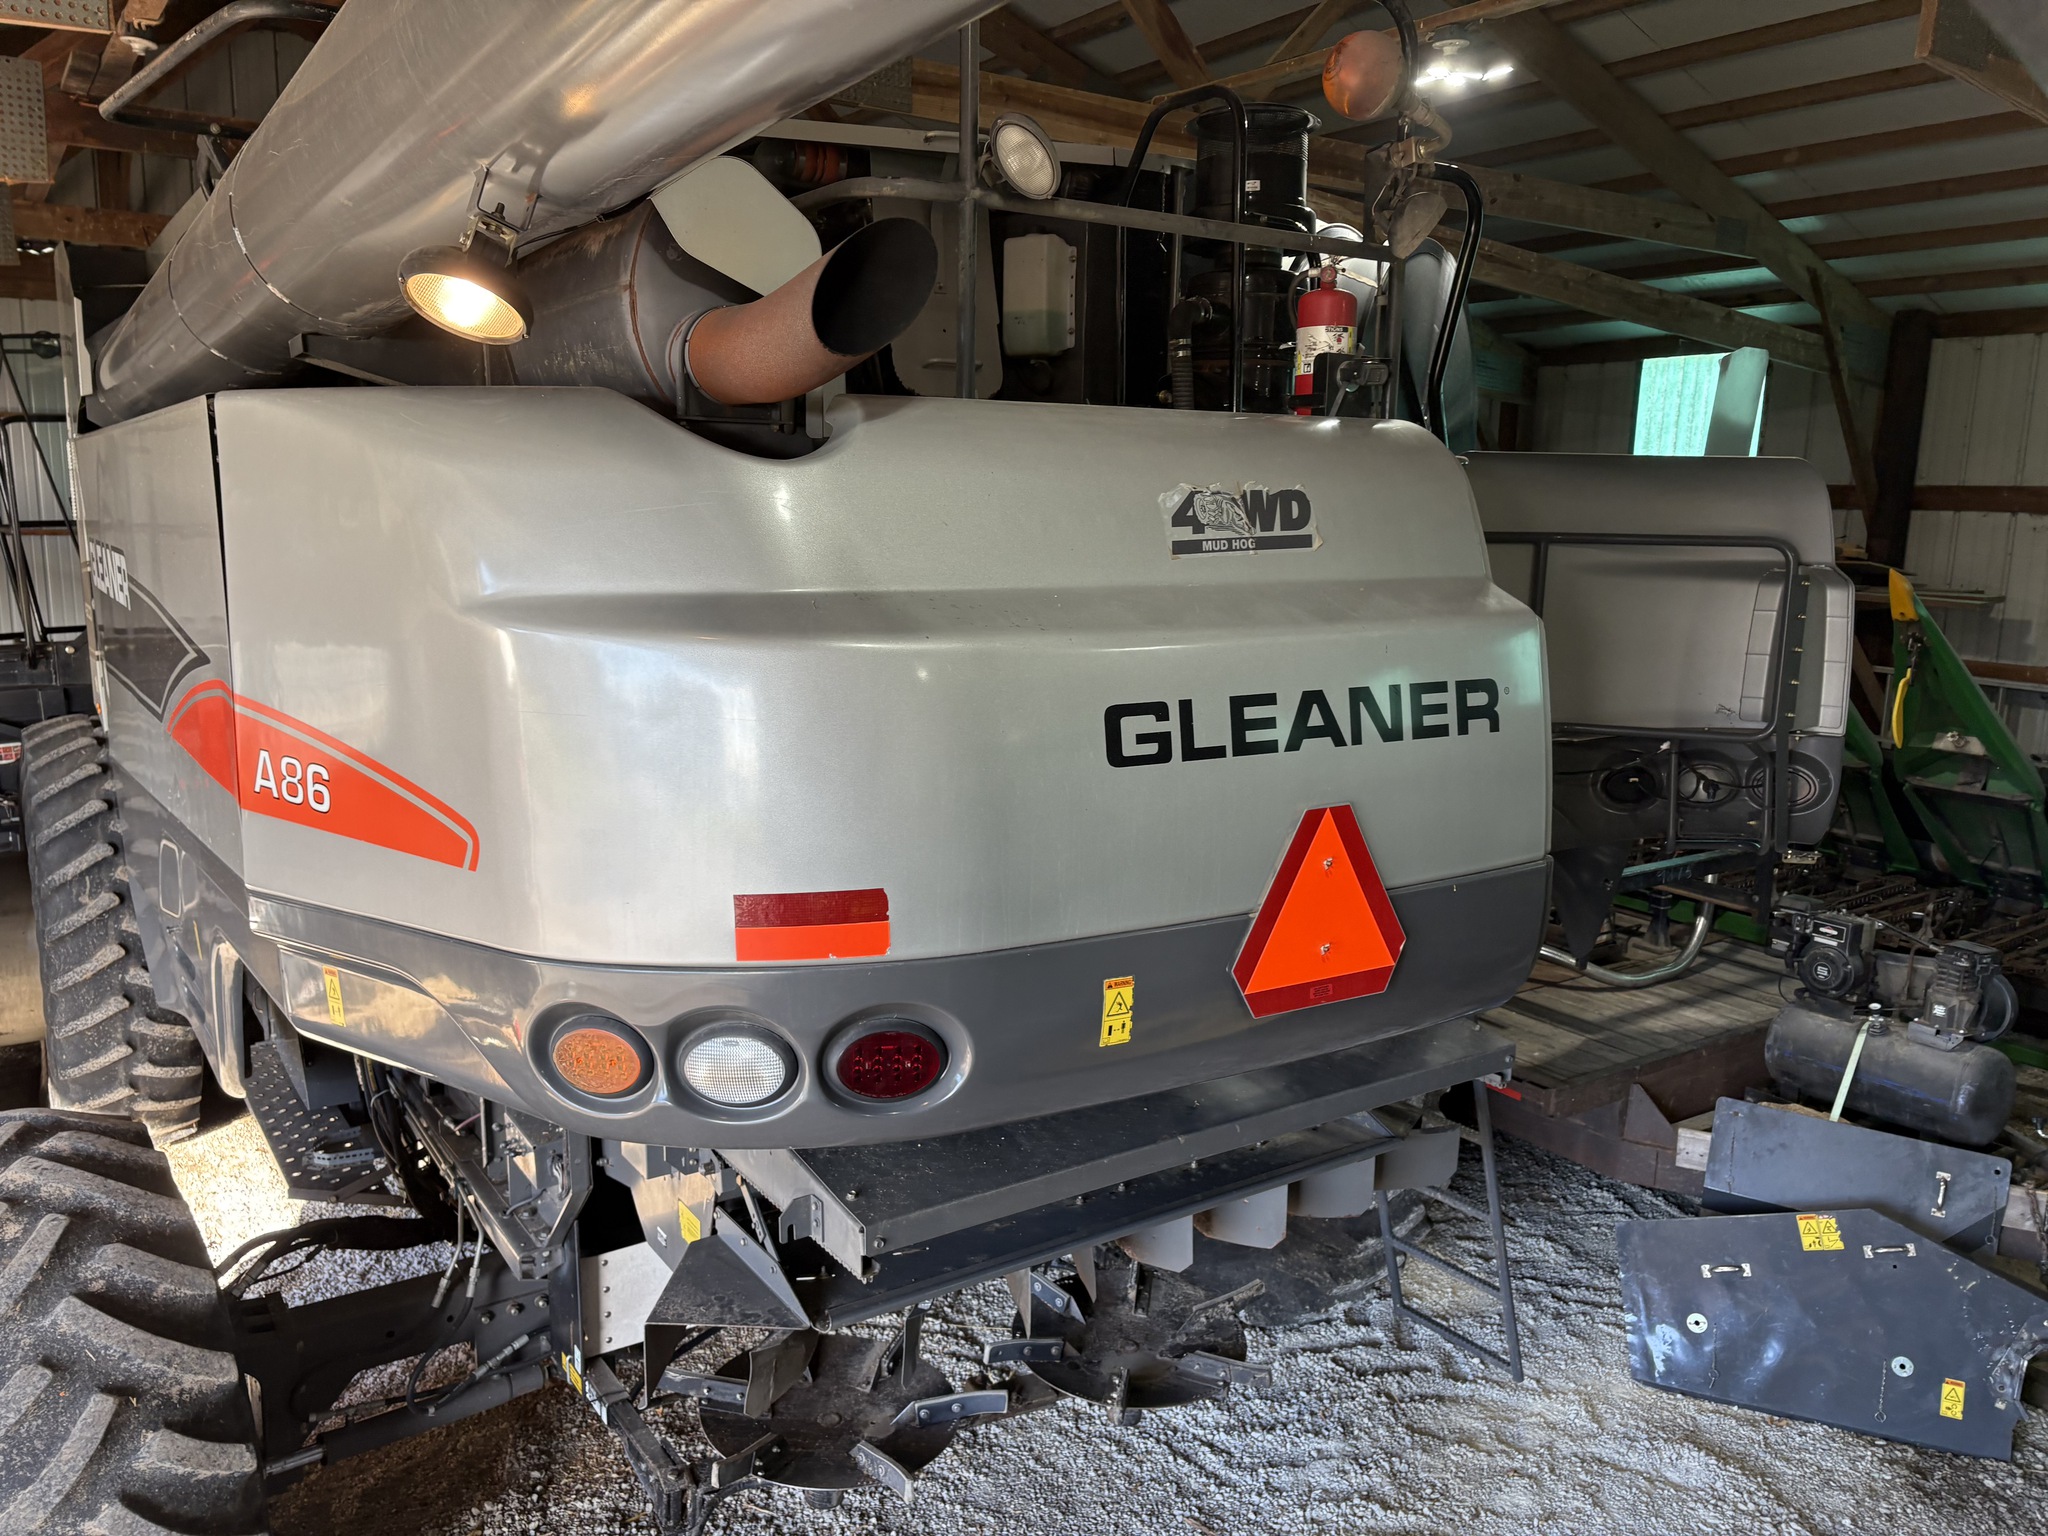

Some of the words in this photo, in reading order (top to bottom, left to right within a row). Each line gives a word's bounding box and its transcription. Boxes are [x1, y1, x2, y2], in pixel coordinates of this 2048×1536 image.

[1202, 540, 1228, 551] MUD
[1232, 538, 1256, 550] HOG
[1104, 678, 1500, 768] GLEANER
[253, 748, 331, 814] A86
